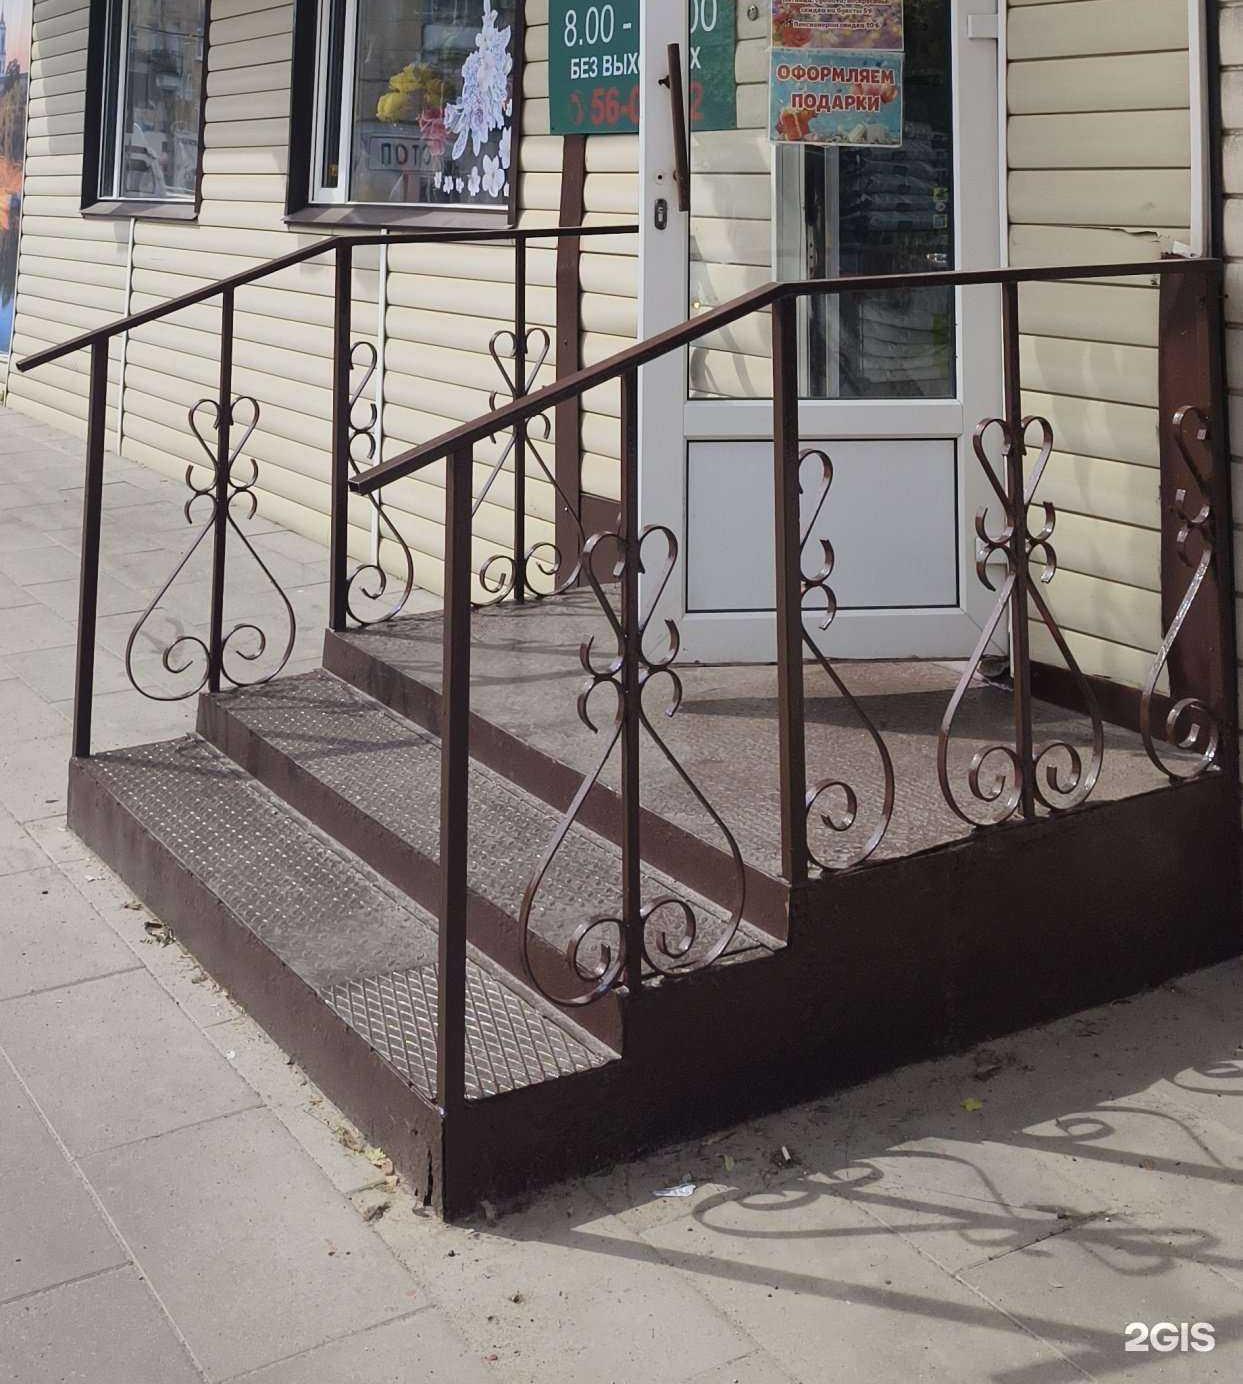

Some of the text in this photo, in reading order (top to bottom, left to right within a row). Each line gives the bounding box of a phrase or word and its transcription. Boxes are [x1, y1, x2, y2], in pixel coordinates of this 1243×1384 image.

[564, 4, 615, 47] 8.00
[570, 56, 598, 80] БЕЗ
[776, 64, 896, 84] ОФОРМЛЯЕМ
[791, 93, 881, 113] ПОДАРКИ
